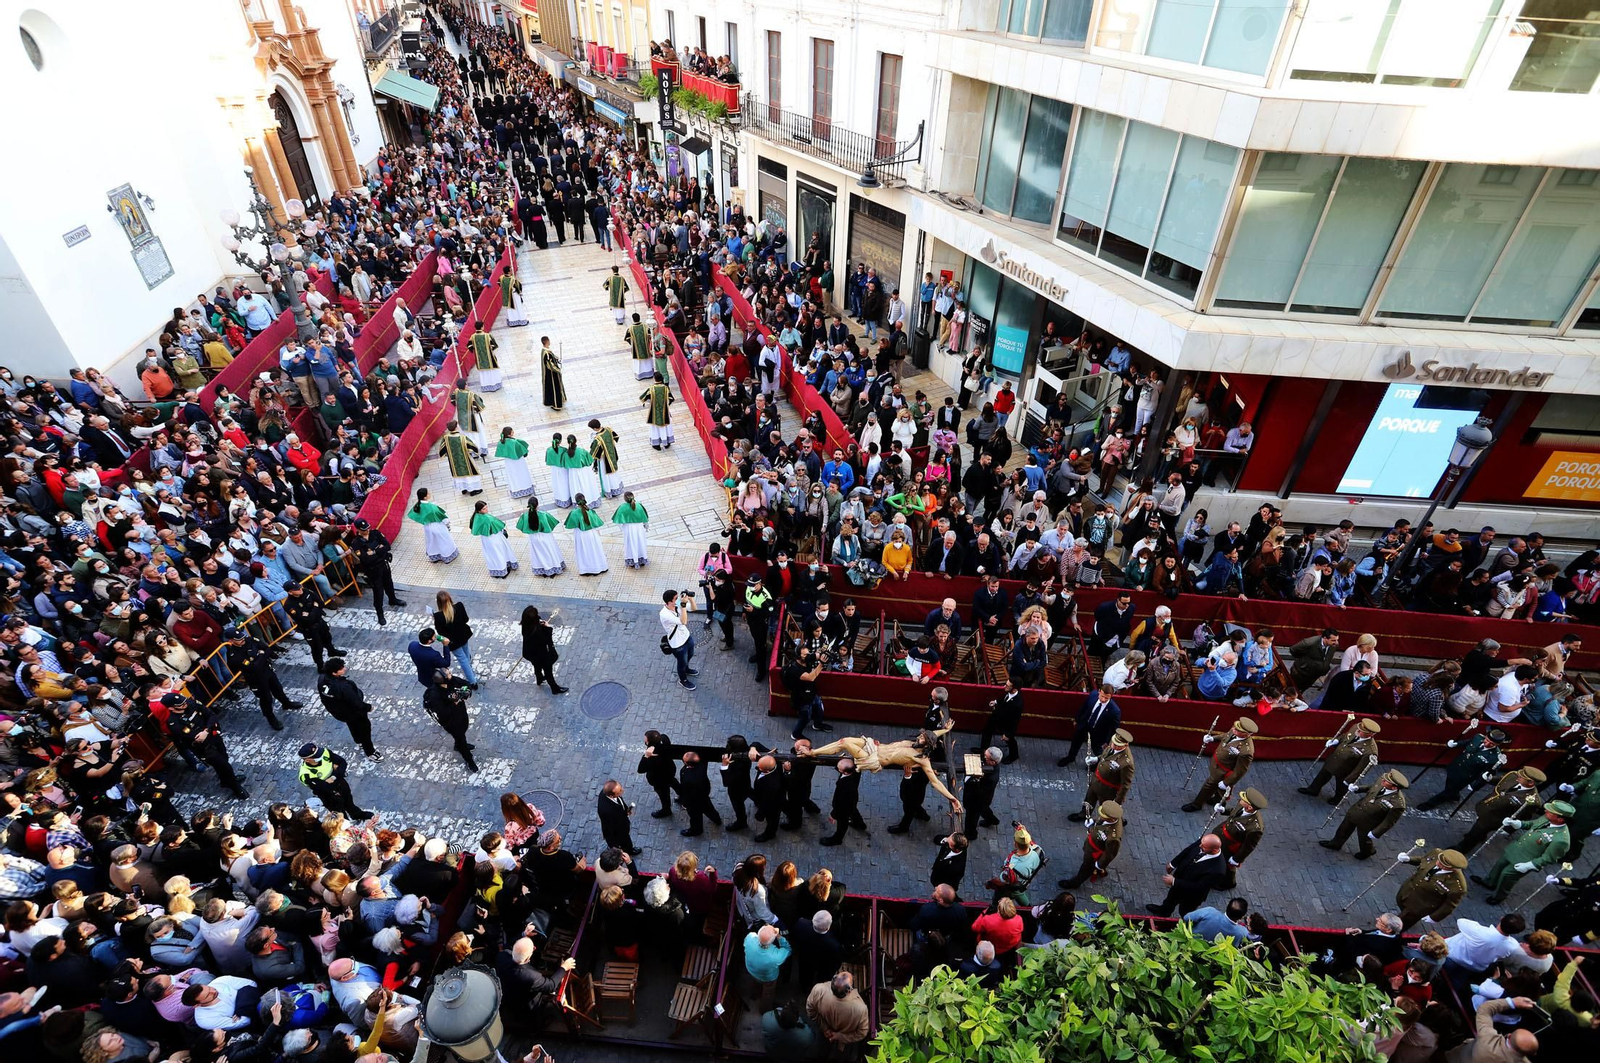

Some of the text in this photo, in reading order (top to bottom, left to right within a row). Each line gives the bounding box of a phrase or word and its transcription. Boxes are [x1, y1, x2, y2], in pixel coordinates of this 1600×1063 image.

[662, 72, 671, 119] NOVI@S
[998, 250, 1069, 302] Santander
[1416, 359, 1554, 388] Santander
[1378, 417, 1441, 433] PORQUE
